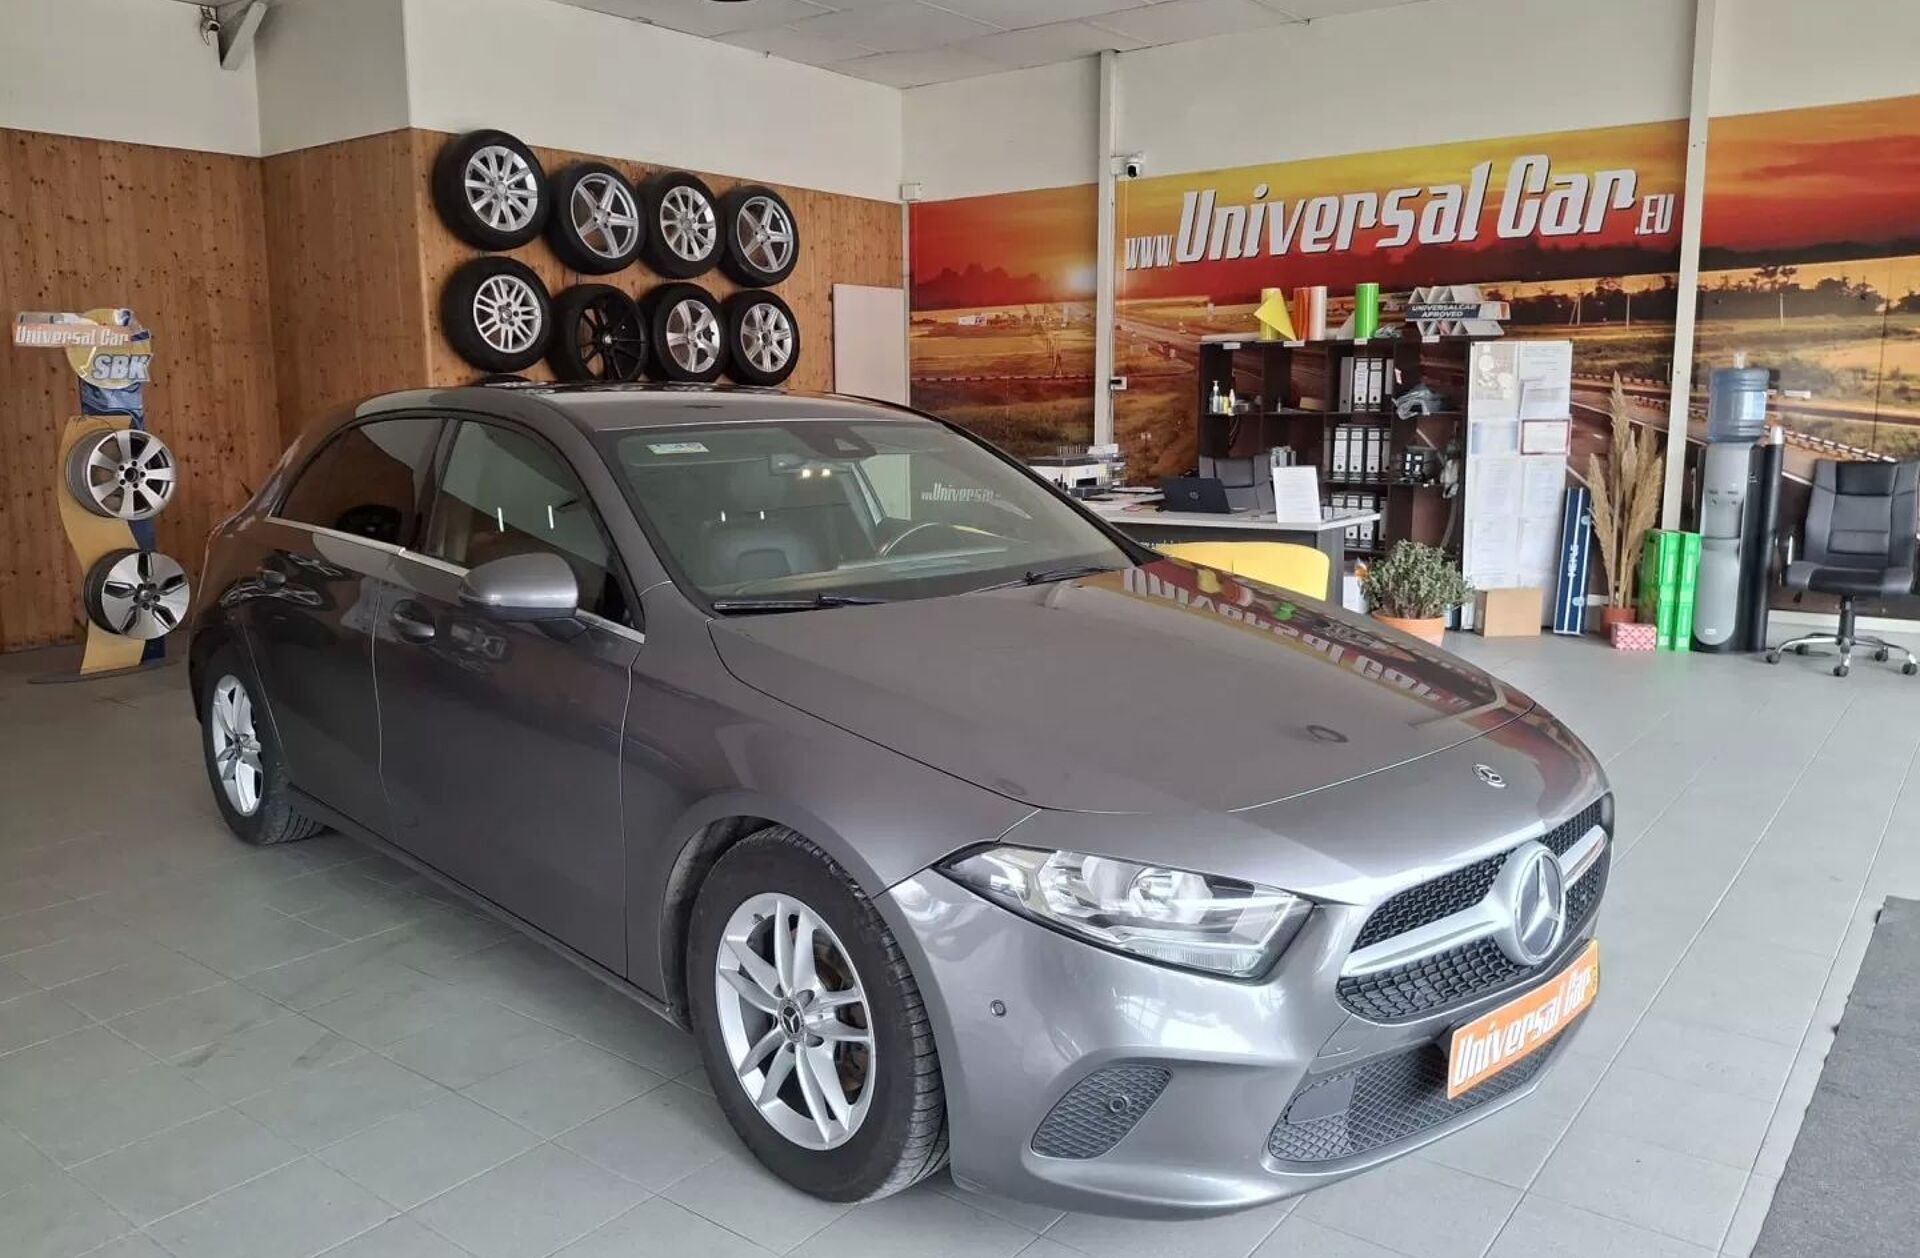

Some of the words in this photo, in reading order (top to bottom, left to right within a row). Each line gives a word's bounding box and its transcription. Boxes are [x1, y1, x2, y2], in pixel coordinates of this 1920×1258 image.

[15, 325, 97, 346] Universal
[100, 326, 131, 346] Car
[92, 353, 149, 380] SBK
[1454, 981, 1564, 1088] Universal
